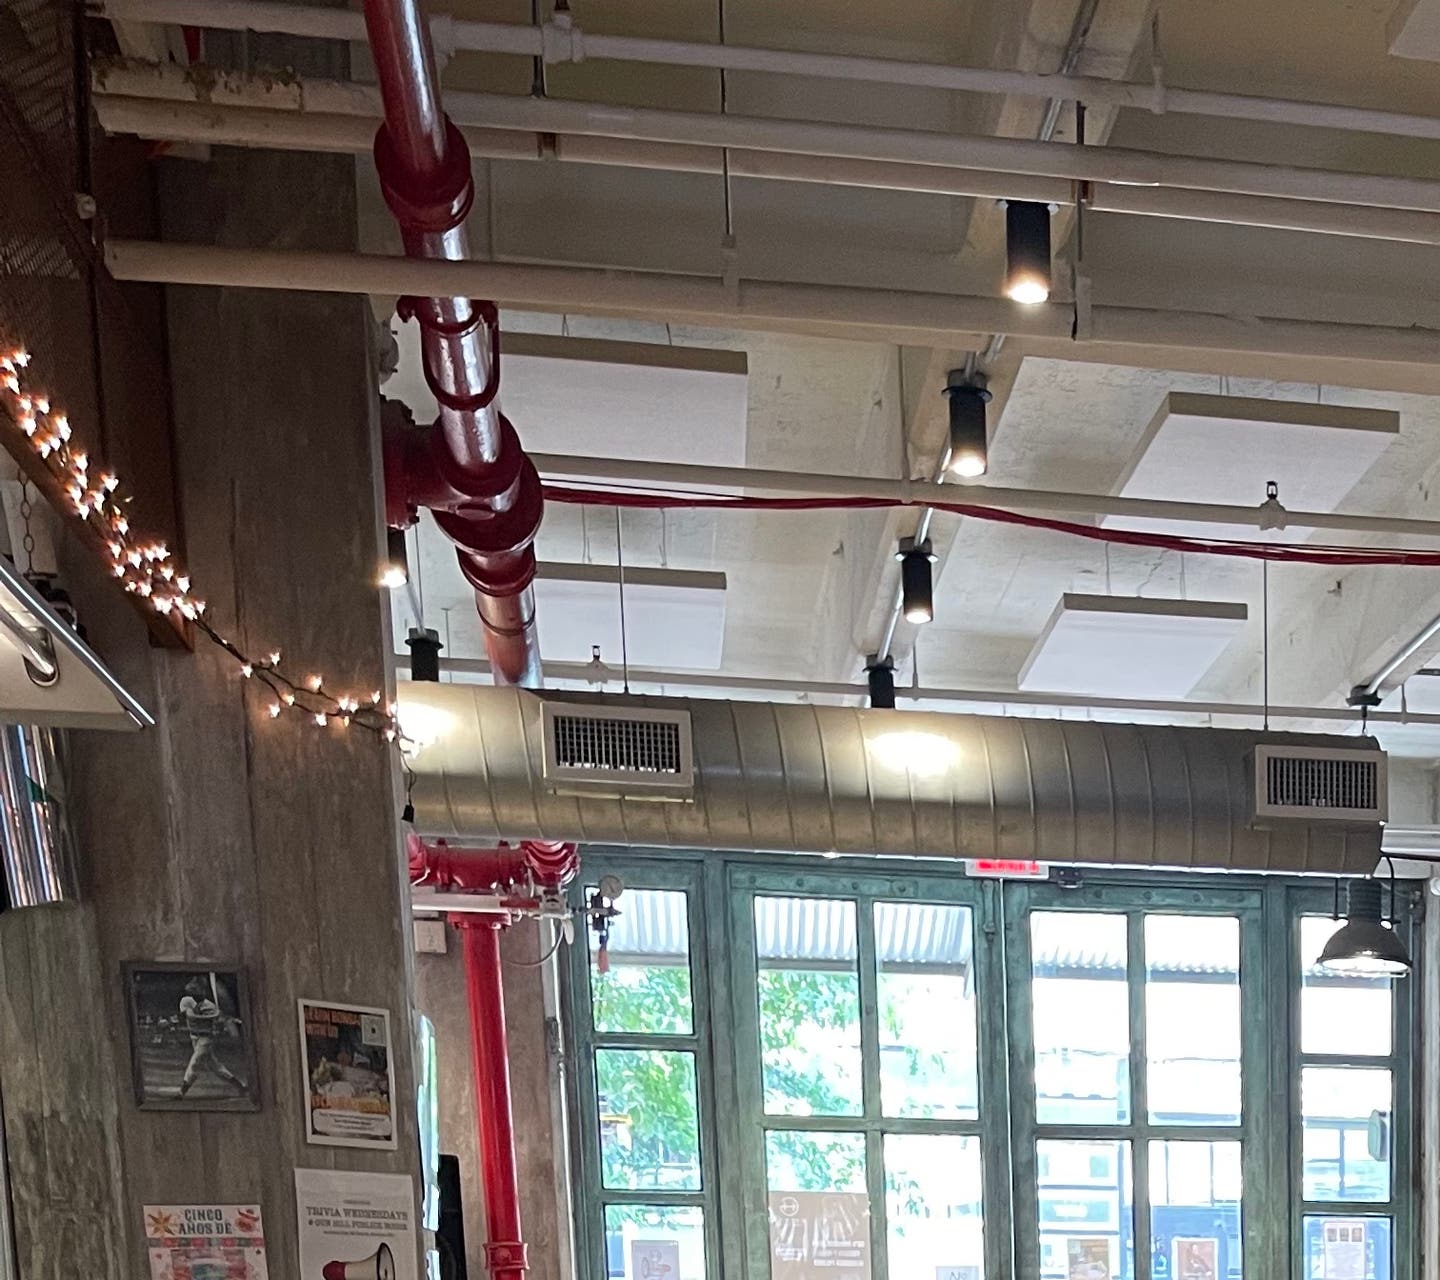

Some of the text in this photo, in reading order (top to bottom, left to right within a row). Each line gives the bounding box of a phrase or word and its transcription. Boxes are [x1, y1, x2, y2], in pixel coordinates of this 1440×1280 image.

[184, 1208, 223, 1222] CINCO
[305, 1206, 342, 1218] TRIVIA
[215, 1222, 233, 1235] DE
